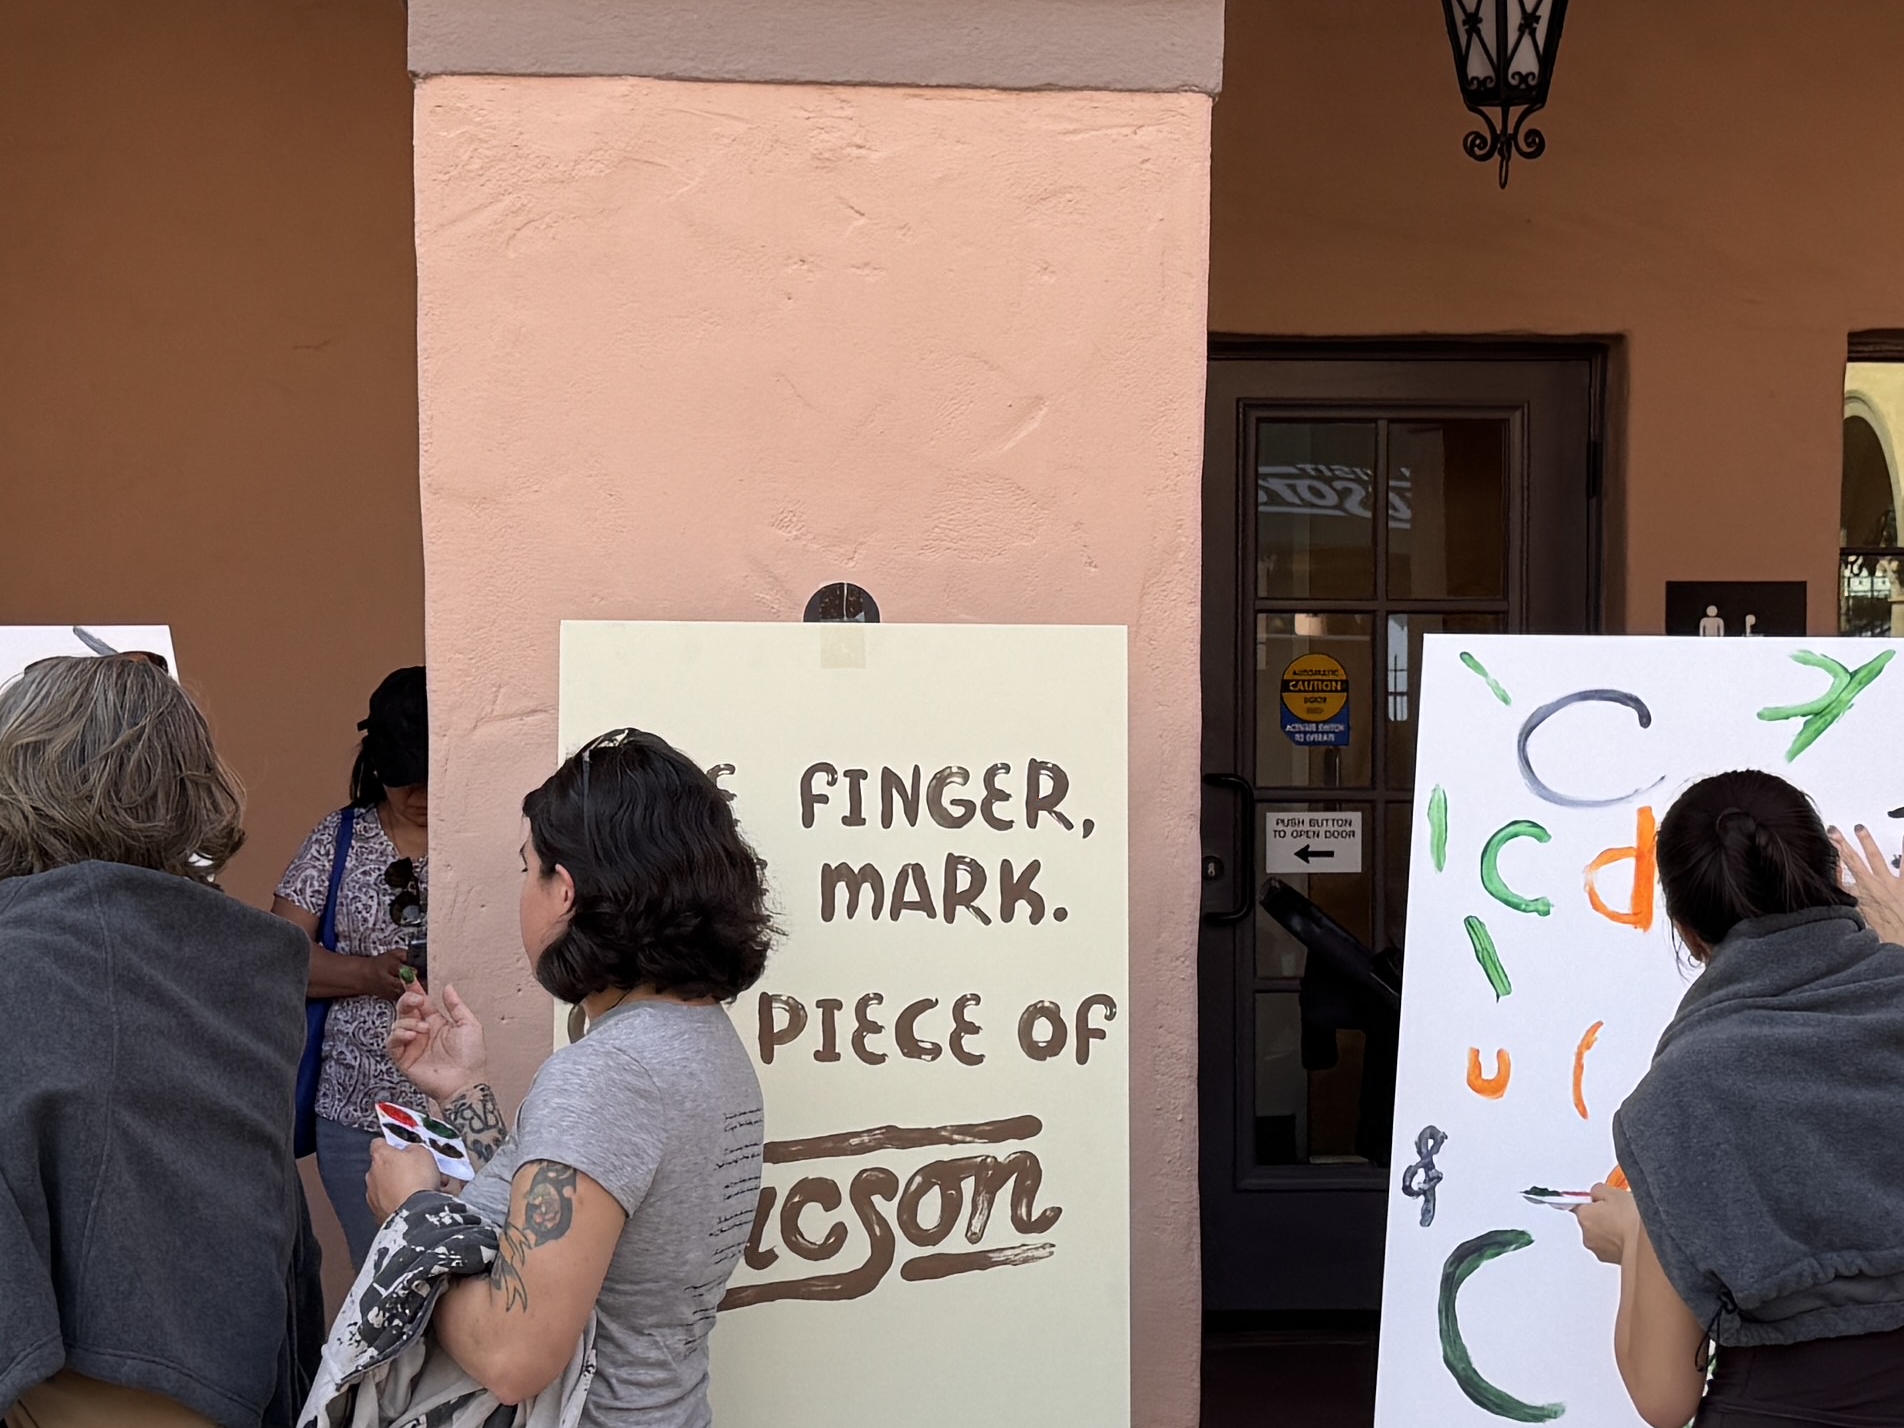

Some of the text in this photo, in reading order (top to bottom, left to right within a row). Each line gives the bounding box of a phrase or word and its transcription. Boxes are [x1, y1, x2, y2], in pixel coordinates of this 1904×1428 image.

[1288, 680, 1342, 691] CAUTION
[800, 758, 1095, 840] FINGER,
[1272, 829, 1356, 839] TO OPEN DOOR
[1275, 818, 1353, 828] PUSH BUTTON
[820, 852, 1069, 926] MARK.
[758, 991, 1117, 1066] PIECE OF
